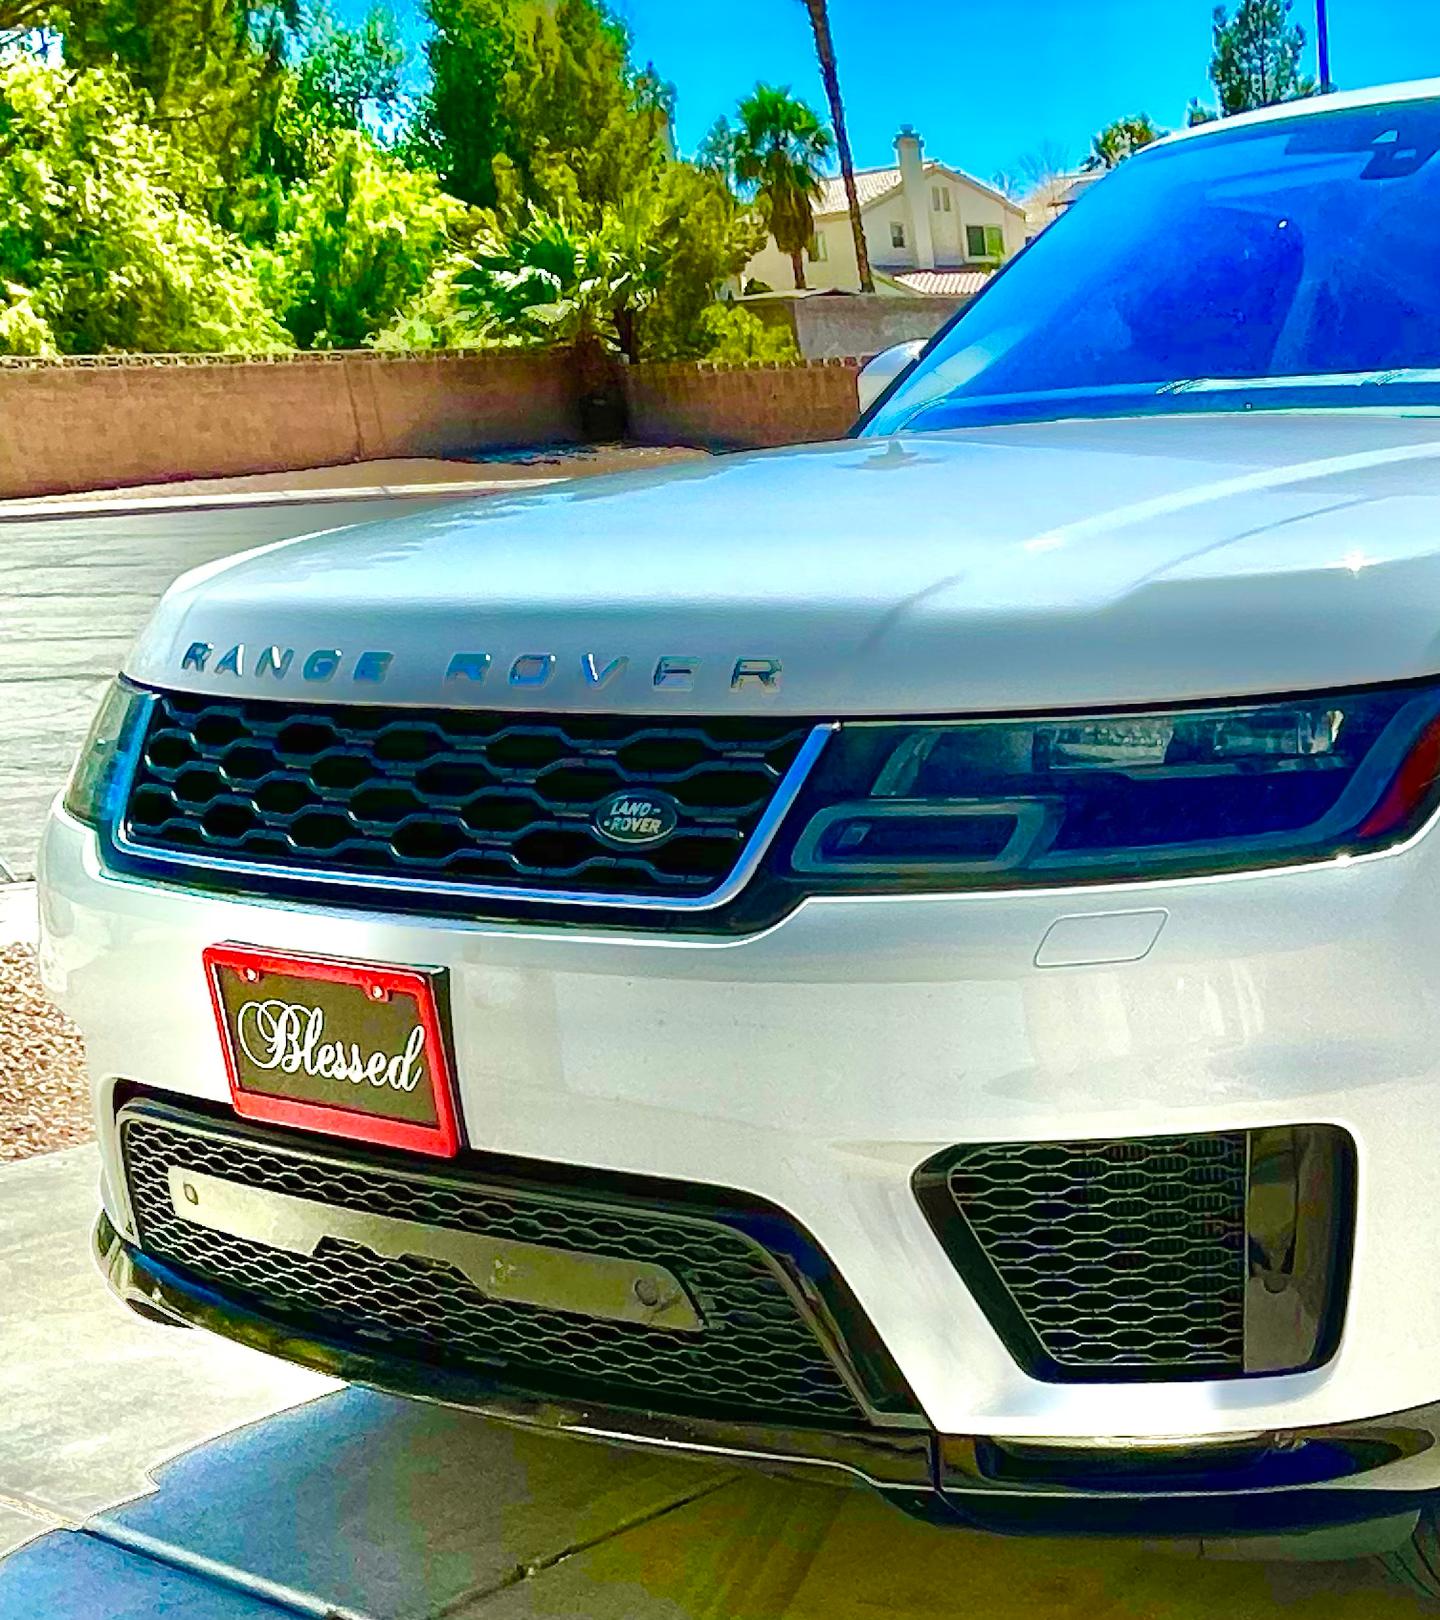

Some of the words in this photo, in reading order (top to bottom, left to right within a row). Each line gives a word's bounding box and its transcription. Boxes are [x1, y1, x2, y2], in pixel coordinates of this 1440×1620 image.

[181, 641, 394, 683] RANGE
[444, 652, 783, 693] ROVER
[236, 999, 426, 1092] Blessed
